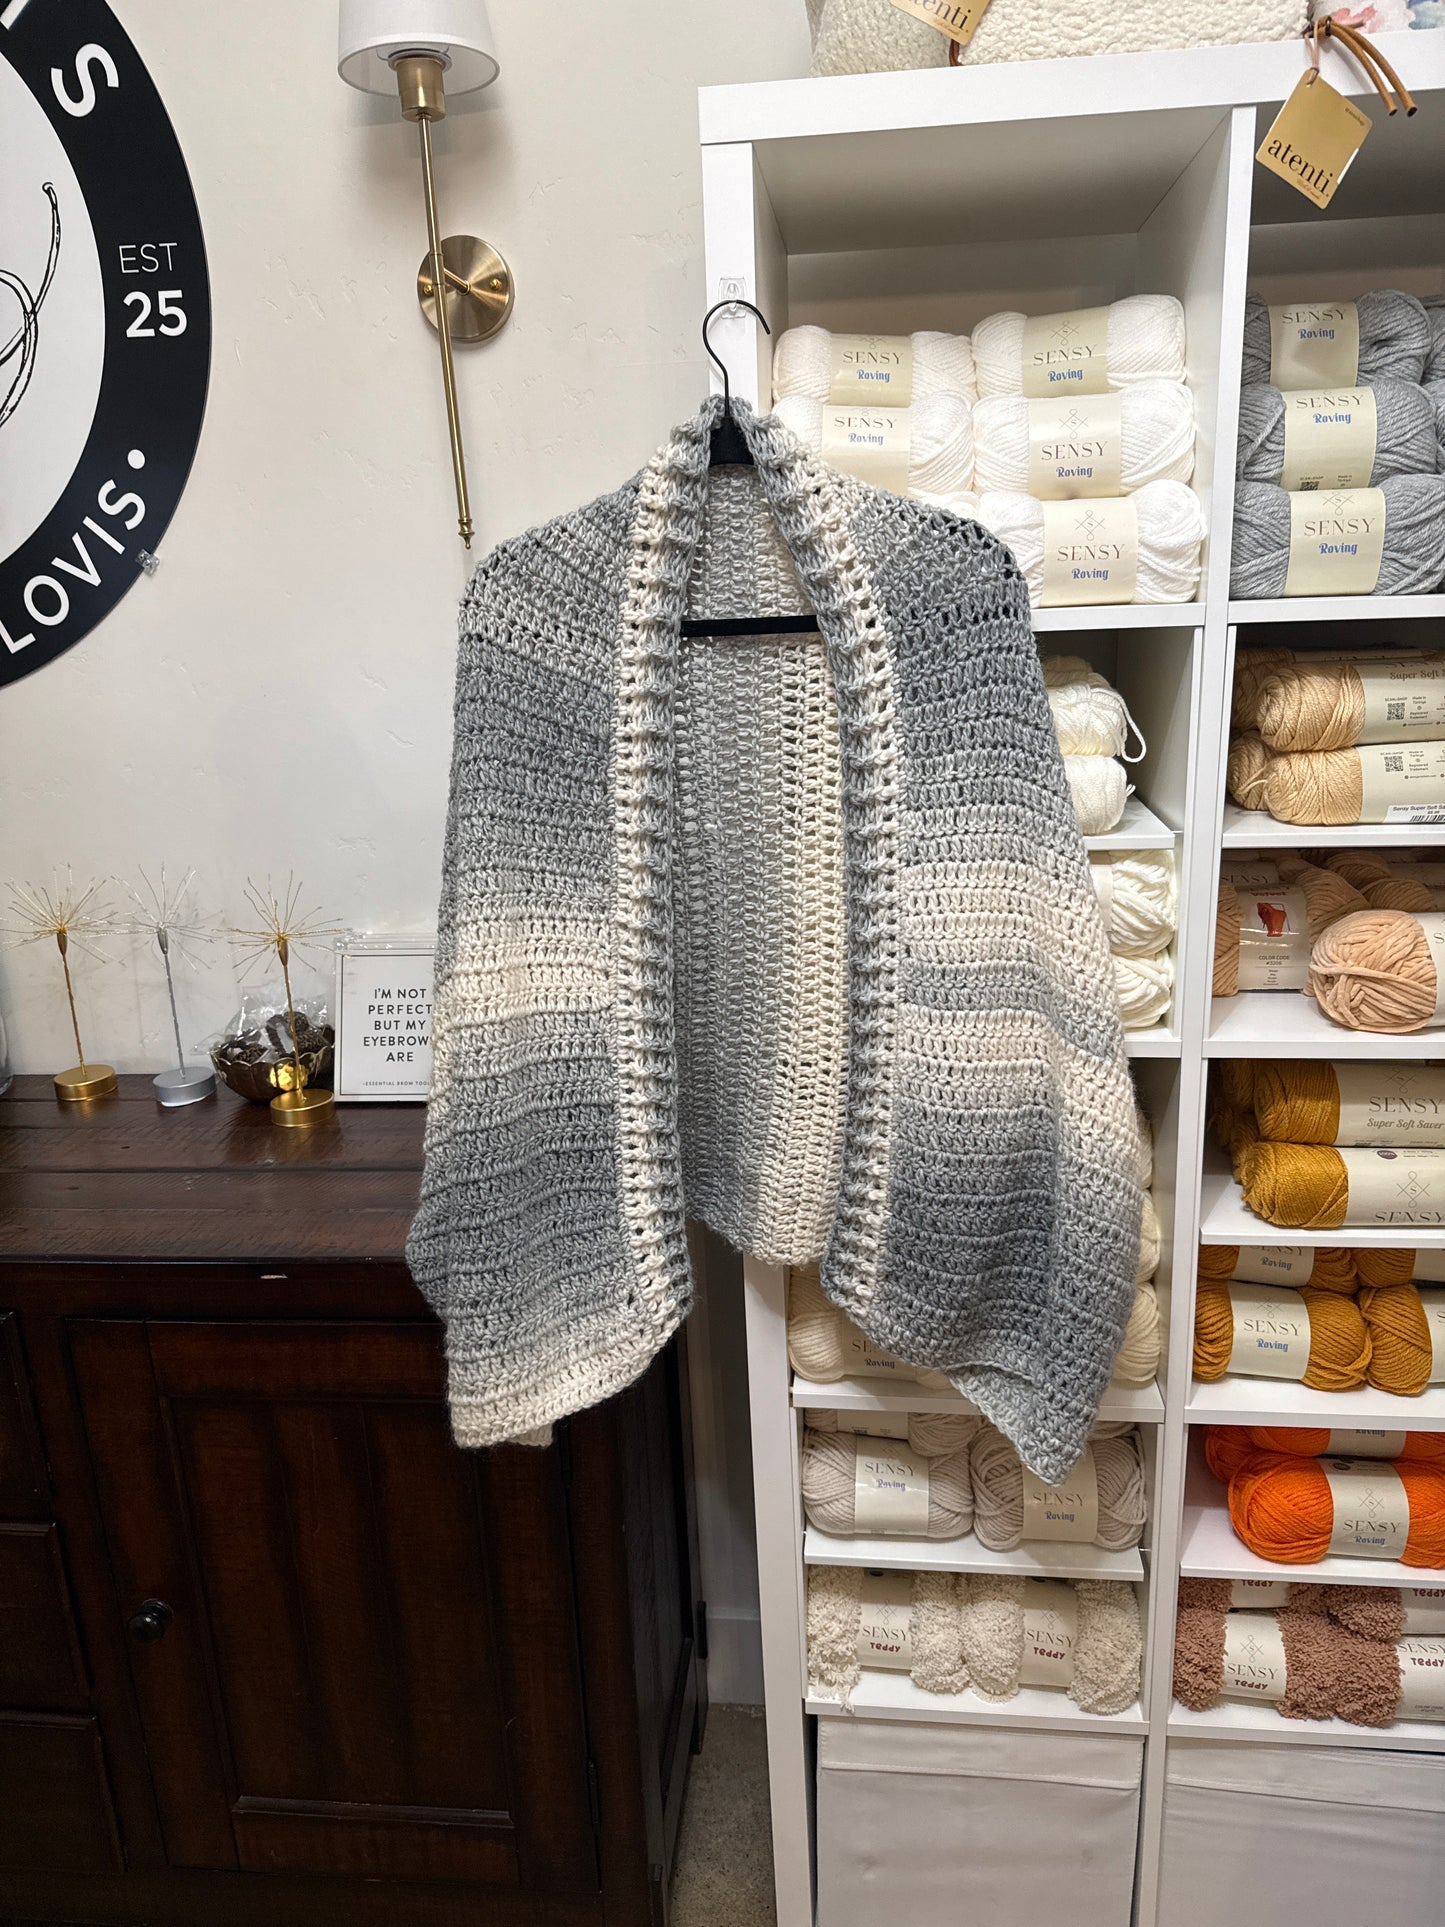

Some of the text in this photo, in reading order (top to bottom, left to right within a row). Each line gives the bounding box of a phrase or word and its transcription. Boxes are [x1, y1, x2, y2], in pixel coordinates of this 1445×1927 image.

[118, 242, 178, 274] EST
[122, 289, 188, 338] 25
[1281, 309, 1349, 324] SENSY
[1297, 327, 1335, 340] Roving
[842, 350, 904, 365] SENSY
[1033, 344, 1097, 367] SENSY
[856, 369, 891, 383] Roving
[1048, 369, 1083, 382] Roving
[1296, 394, 1364, 409] SENSY
[834, 416, 897, 429] SENSY
[1312, 412, 1352, 425] Roving
[848, 432, 884, 446] Roving
[1041, 441, 1108, 461] SENSY
[1056, 466, 1094, 479] Roving
[1303, 517, 1376, 537] SENSY
[1056, 544, 1126, 562] SENSY
[1318, 542, 1359, 555] Roving
[1071, 567, 1110, 581] Roving
[1390, 671, 1418, 682] Super
[1420, 669, 1440, 680] Soft
[397, 988, 427, 999] NOT
[368, 1004, 432, 1015] PERFECT
[374, 1020, 426, 1031] BUT MY
[363, 1036, 431, 1047] EYEBROW
[386, 1052, 414, 1062] ARE
[1369, 1096, 1442, 1115] SENSY
[1367, 1118, 1445, 1130] Super Soft Saver
[1261, 1257, 1293, 1271] Roving
[1243, 1319, 1301, 1337] SENSY
[1256, 1338, 1289, 1353] Roving
[865, 1358, 896, 1369] Roving
[865, 1462, 915, 1477] SENSY
[876, 1478, 906, 1491] Roving
[1032, 1492, 1087, 1508] SENSY
[1045, 1511, 1075, 1522] Roving
[1343, 1520, 1401, 1533] SENSY
[1354, 1535, 1386, 1546] Roving
[862, 1624, 908, 1642] SENSY
[1026, 1629, 1074, 1649] SENSY
[870, 1642, 901, 1653] Teddy
[1033, 1646, 1066, 1660] Teddy
[1227, 1662, 1279, 1680] SENSY
[1234, 1679, 1268, 1691] Teddy
